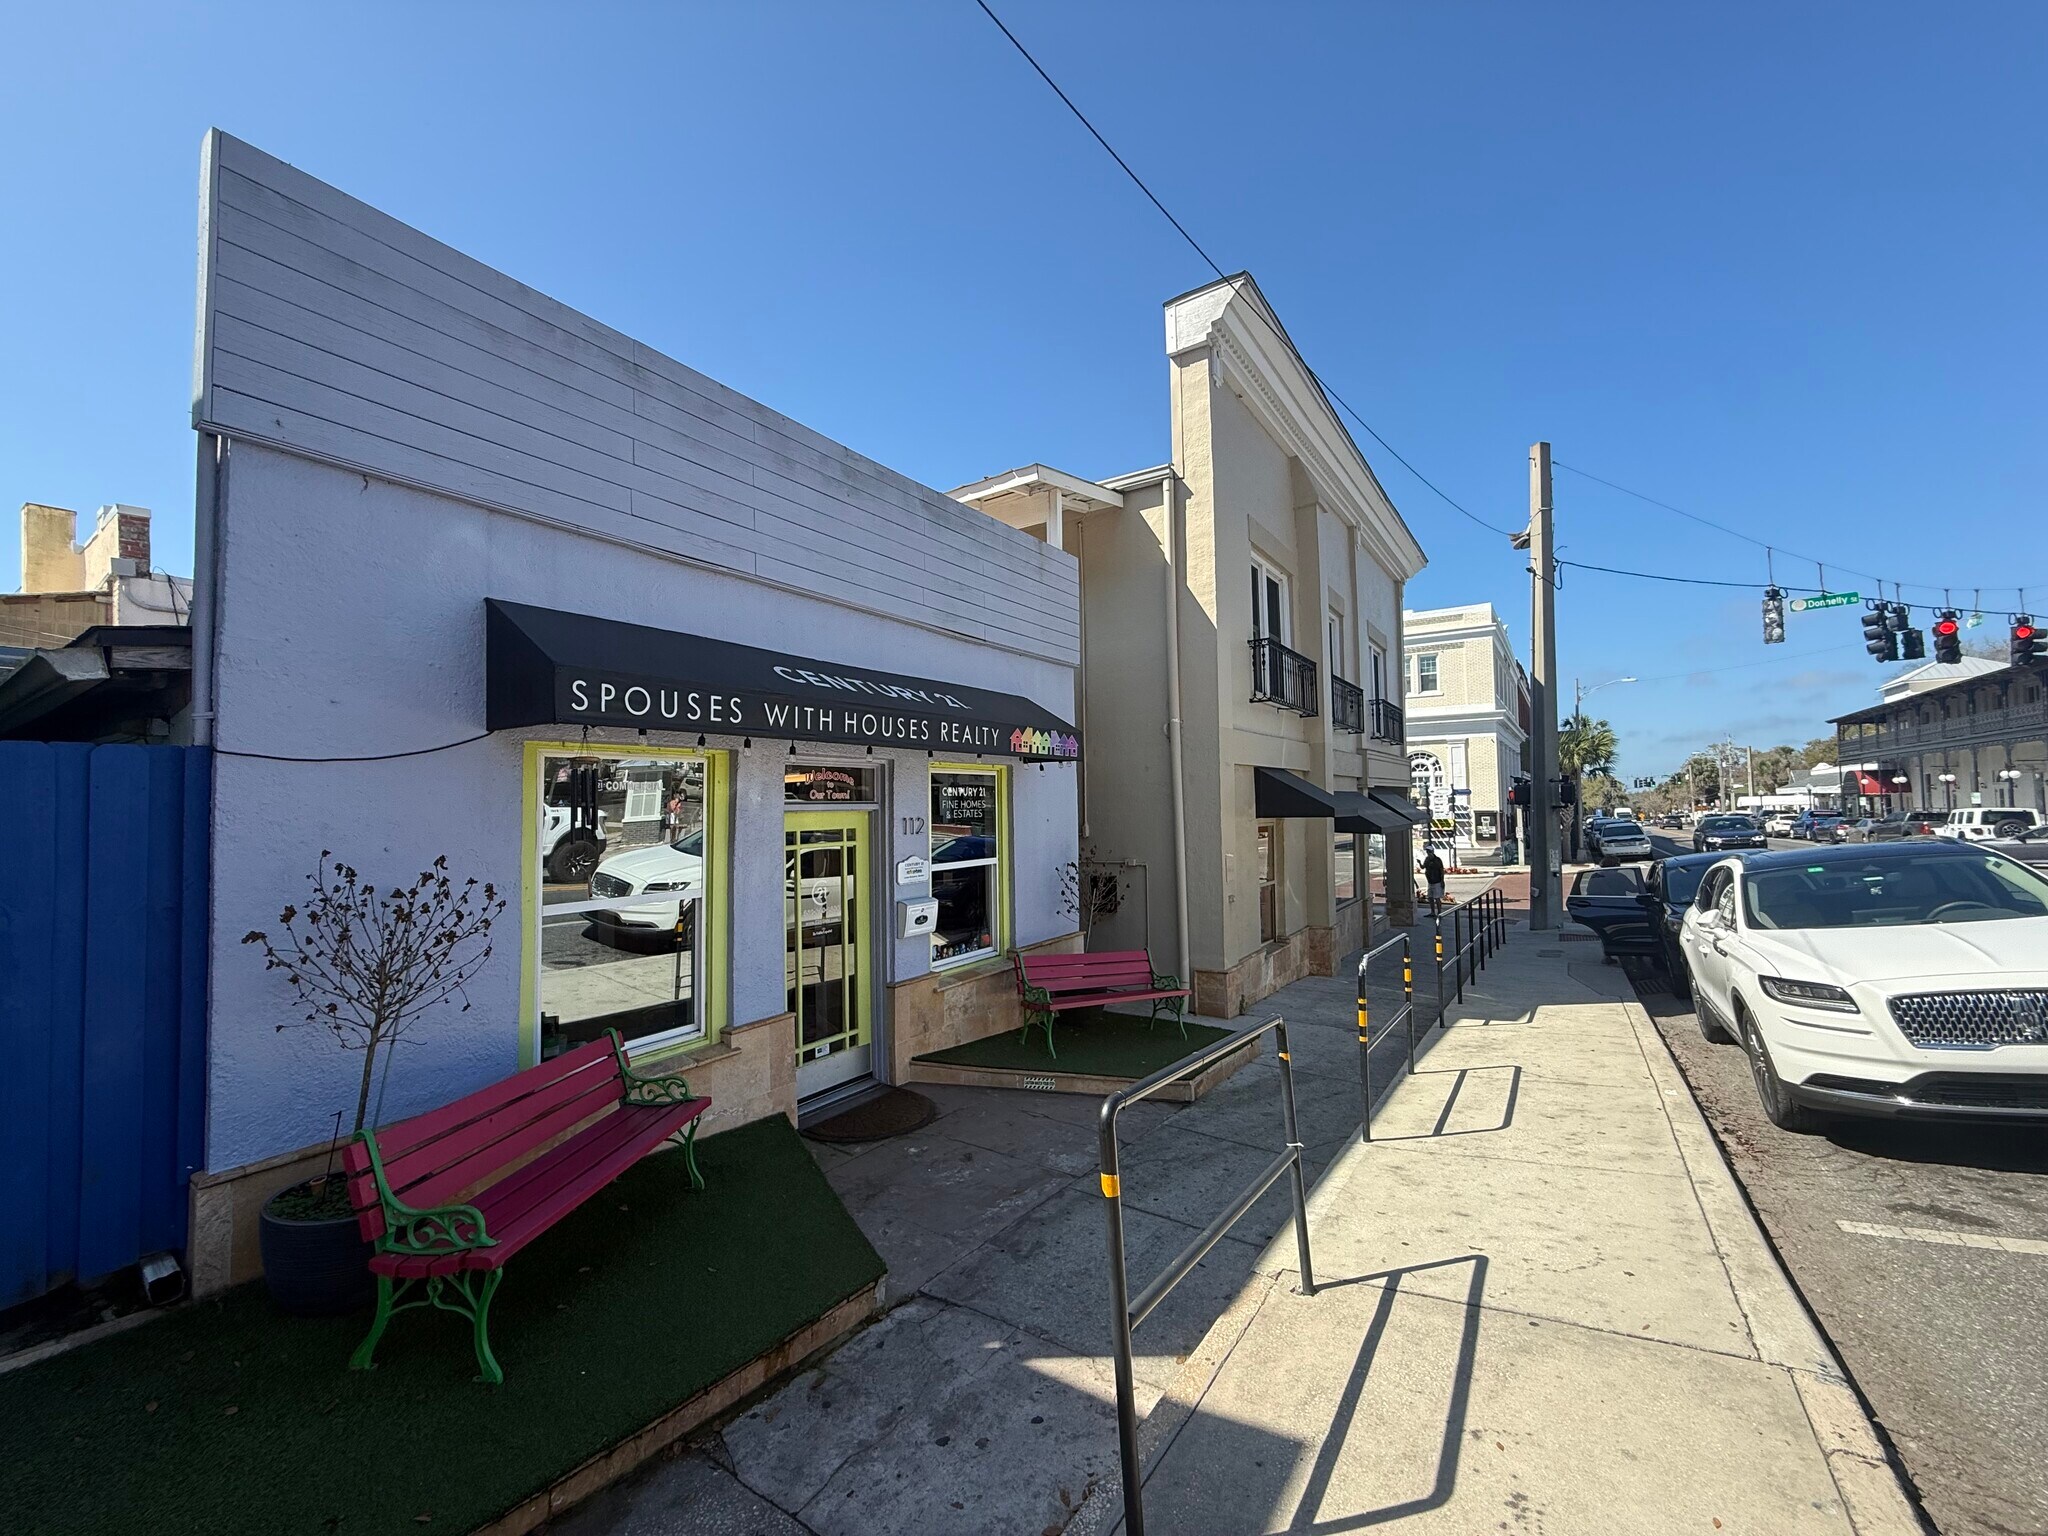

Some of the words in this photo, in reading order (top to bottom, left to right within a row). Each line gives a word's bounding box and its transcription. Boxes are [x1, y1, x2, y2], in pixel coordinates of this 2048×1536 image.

[1808, 596, 1847, 608] Donnelly
[773, 666, 934, 704] CENTURY
[933, 692, 971, 710] 21
[571, 680, 742, 724] SPOUSES
[764, 702, 833, 732] WITH
[844, 711, 929, 740] HOUSES
[940, 721, 1000, 747] REALTY
[804, 767, 855, 786] Welcome
[826, 781, 835, 789] to
[809, 789, 826, 800] Our
[826, 789, 850, 800] Town!
[942, 786, 978, 797] CENTURY
[978, 786, 986, 797] 21
[942, 800, 959, 809] FINE
[960, 800, 986, 809] HOMES
[946, 810, 951, 819] &
[953, 809, 983, 819] ESTATES
[902, 817, 925, 835] 112
